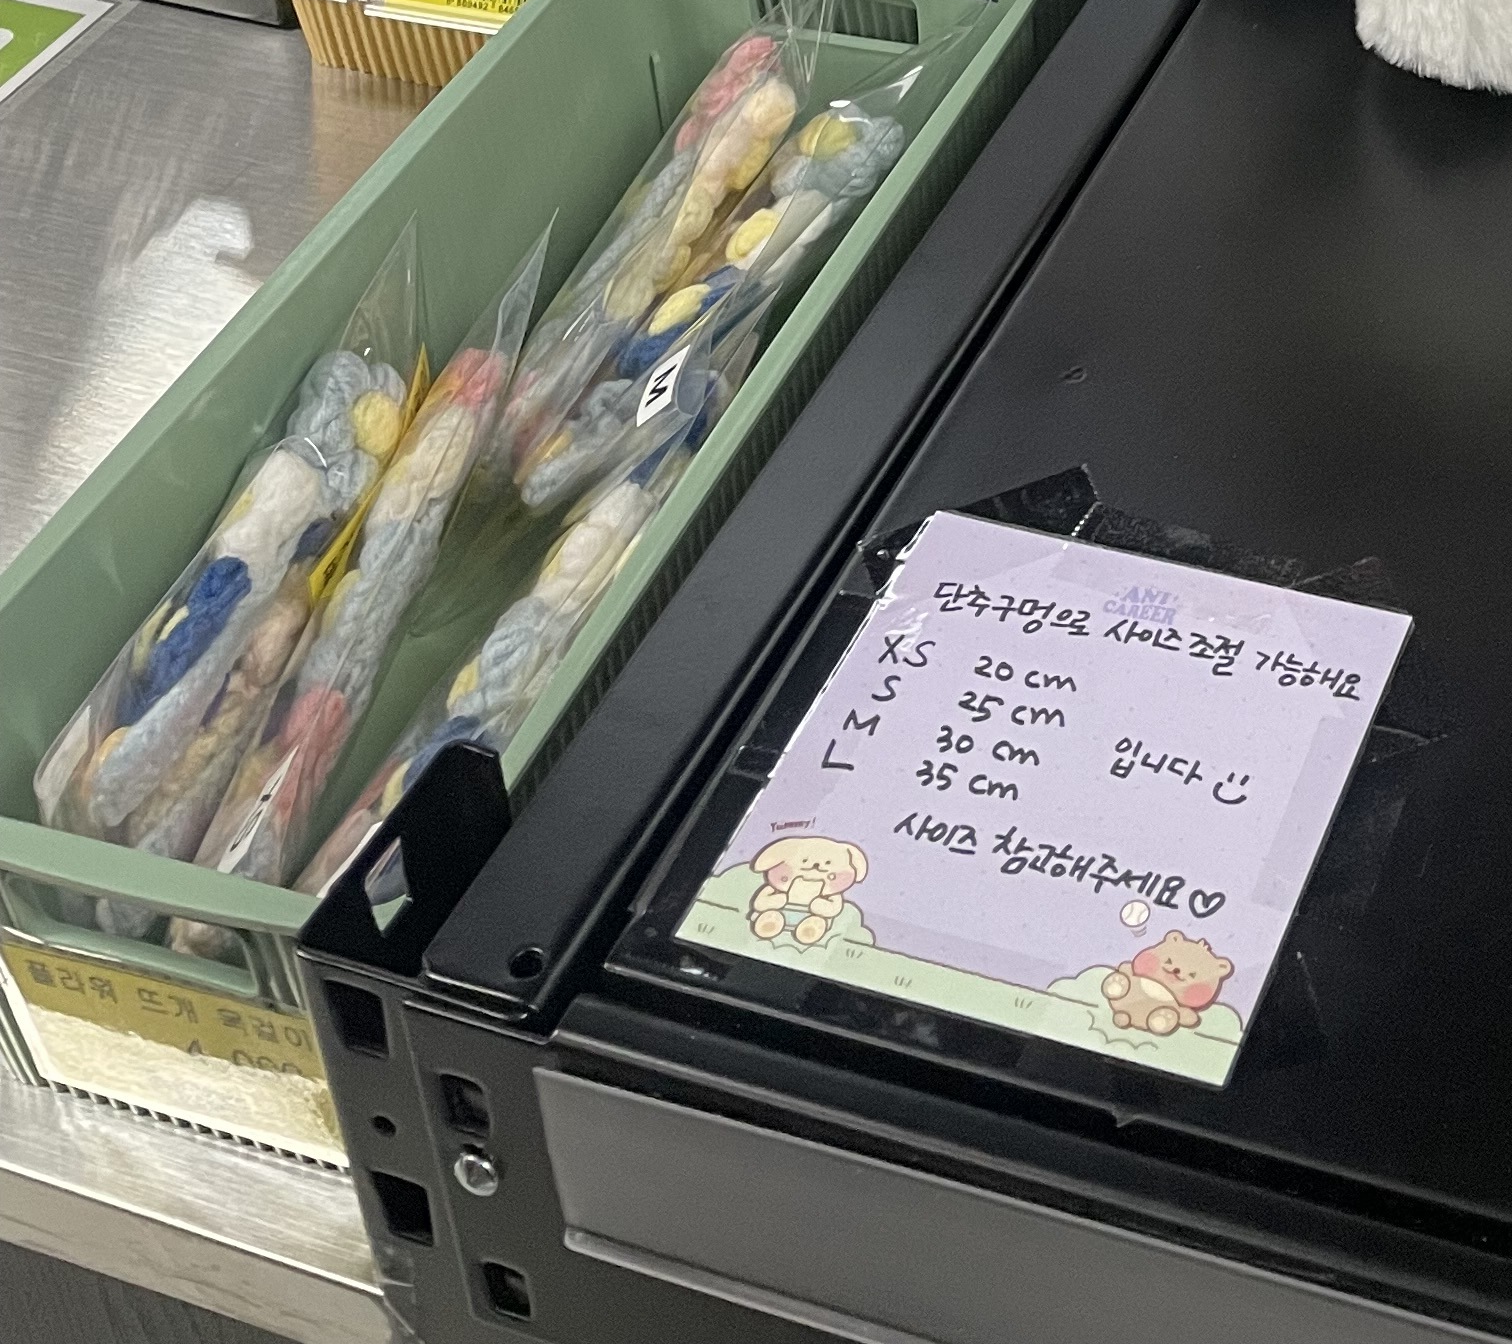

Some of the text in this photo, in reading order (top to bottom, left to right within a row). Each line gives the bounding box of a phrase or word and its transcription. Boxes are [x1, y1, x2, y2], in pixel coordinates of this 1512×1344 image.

[878, 634, 1078, 693] XS 20 cm
[933, 581, 1092, 638] 단추구멍으로
[1256, 650, 1363, 702] 가능해요
[871, 675, 1065, 728] S 25 cm
[843, 709, 1041, 767] M 30 cm
[1109, 736, 1204, 783] 입니다
[821, 738, 1019, 801] L 35 cm
[893, 812, 977, 856] 사이즈
